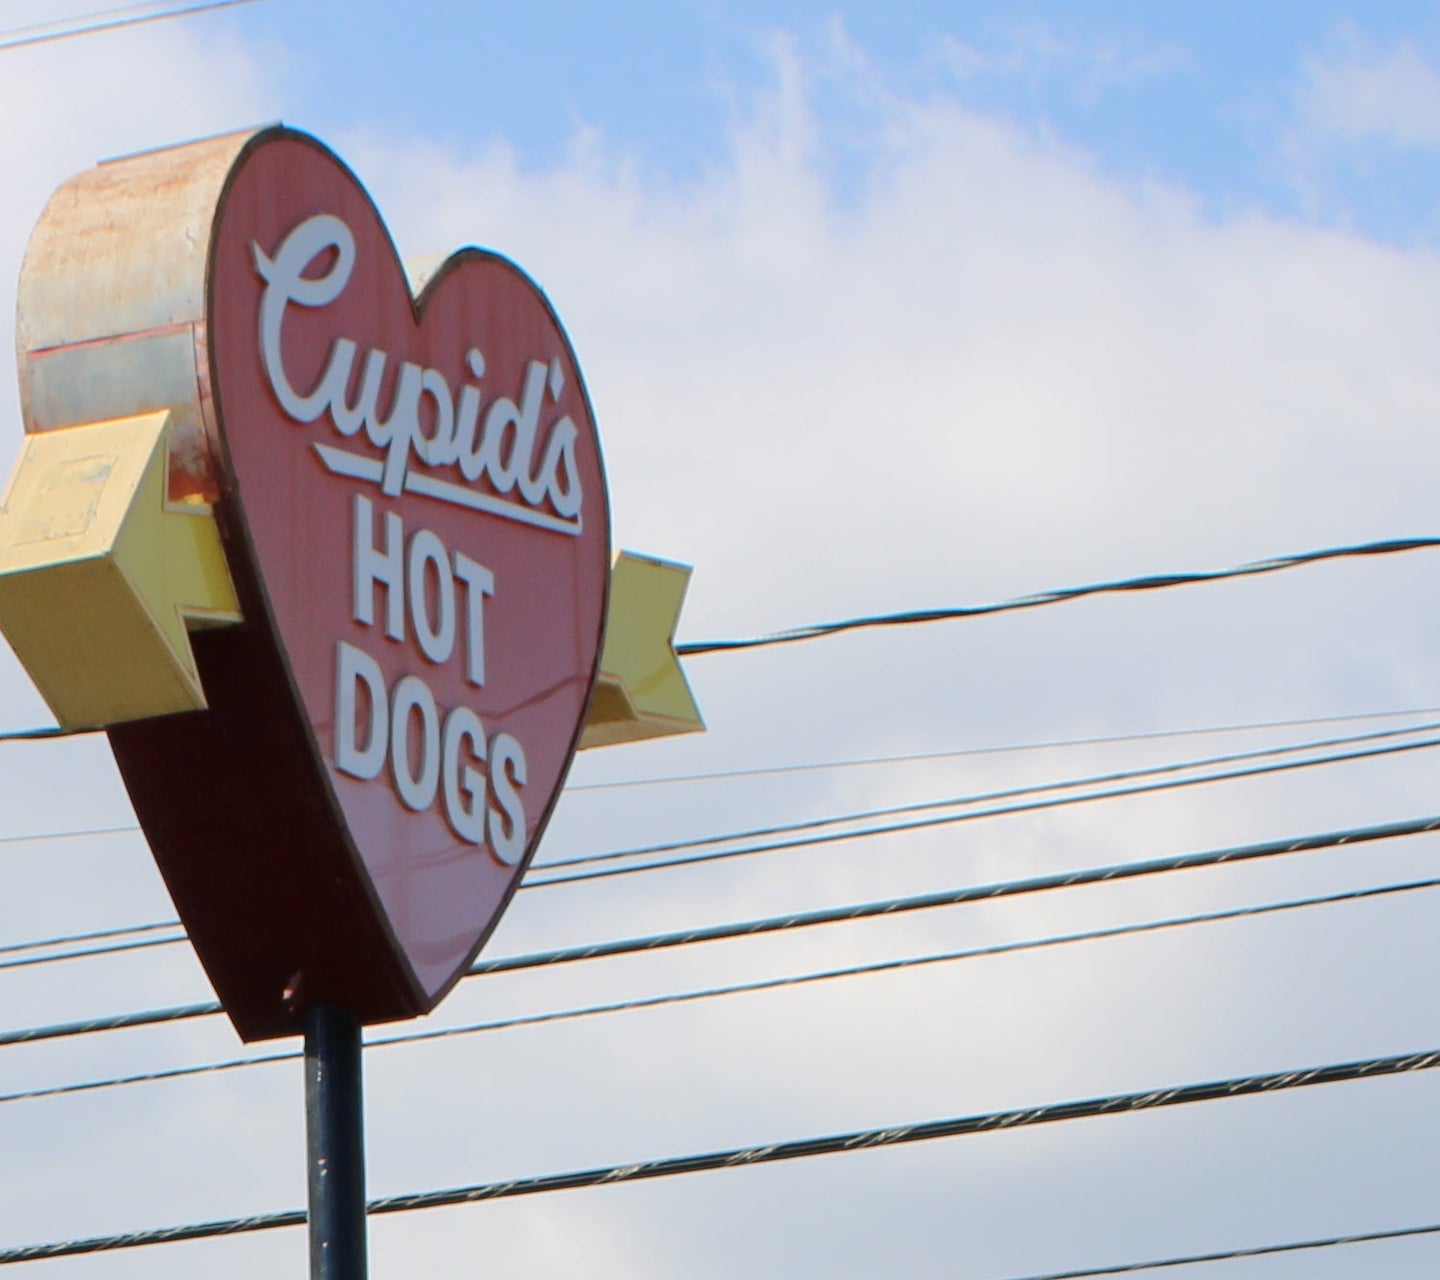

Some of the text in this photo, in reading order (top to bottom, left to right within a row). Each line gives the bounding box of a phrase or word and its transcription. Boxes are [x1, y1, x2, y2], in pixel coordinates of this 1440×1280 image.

[250, 213, 583, 519] Cupid's
[353, 493, 495, 686] HOT
[334, 640, 529, 868] DOGS
